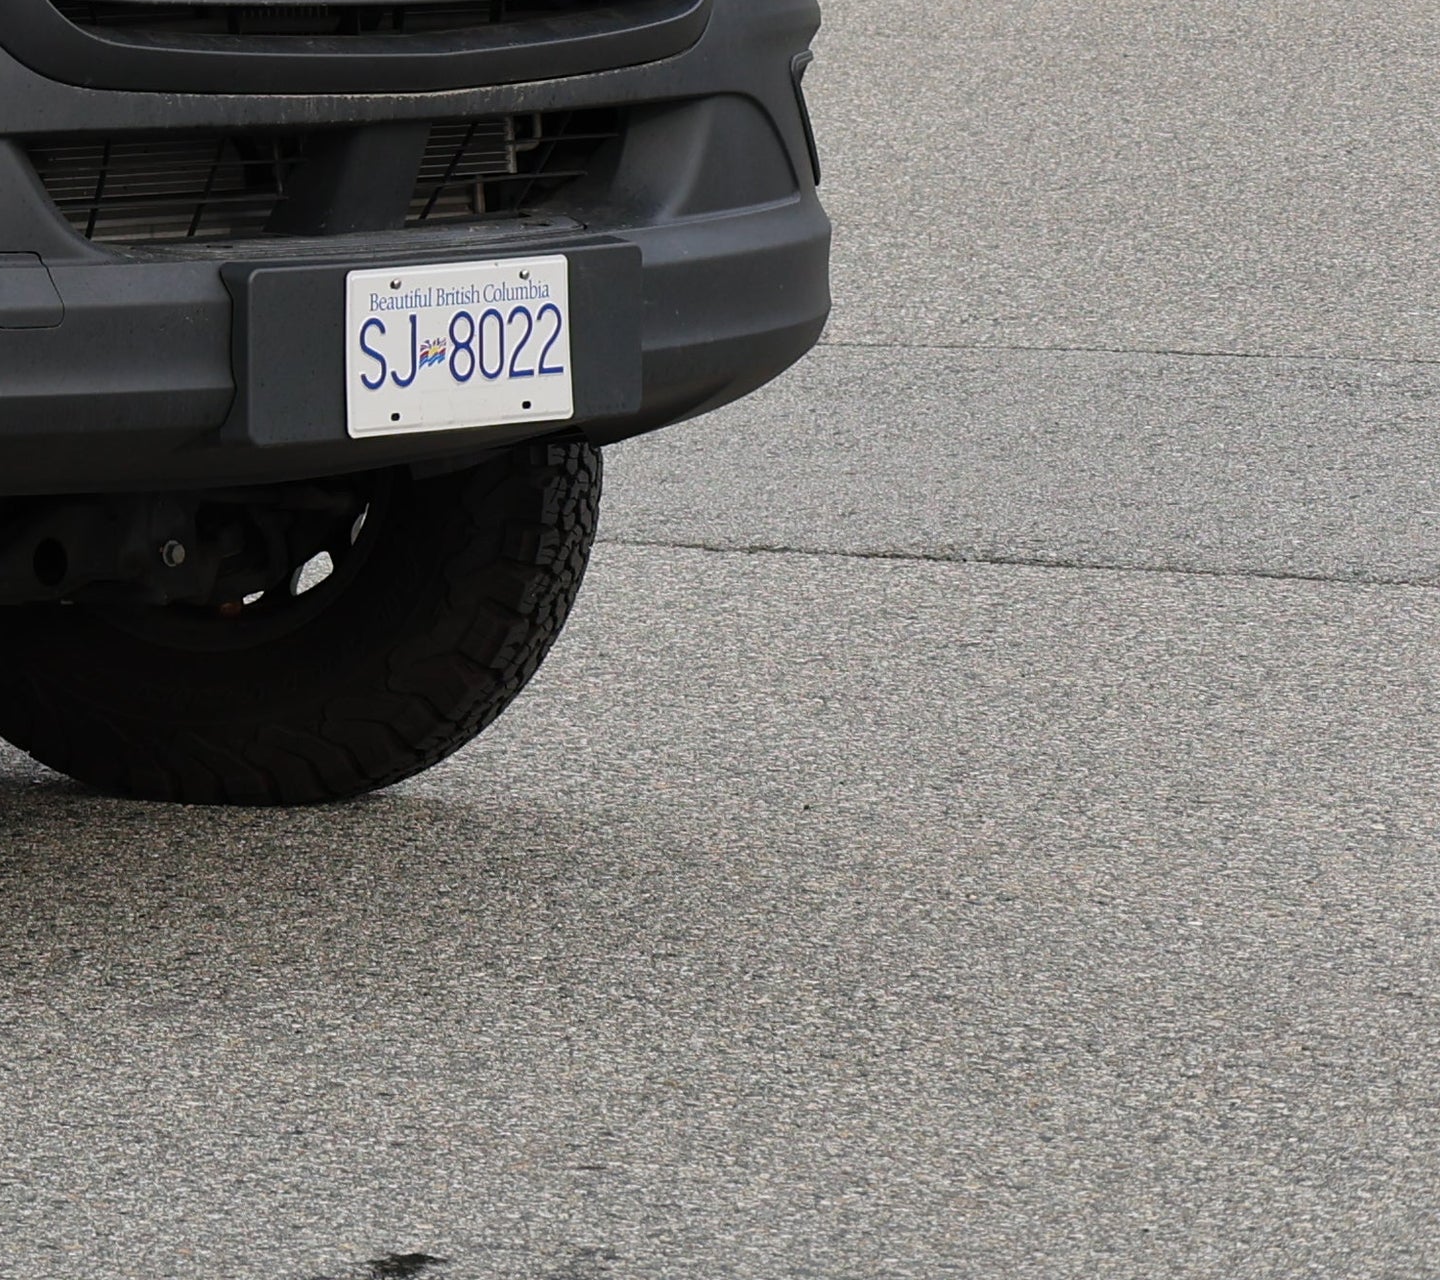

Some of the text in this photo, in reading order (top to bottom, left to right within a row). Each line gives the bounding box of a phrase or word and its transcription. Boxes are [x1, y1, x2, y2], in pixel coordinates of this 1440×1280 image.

[369, 279, 550, 312] Beautiful British Columbia
[359, 303, 564, 390] SJ 8022
